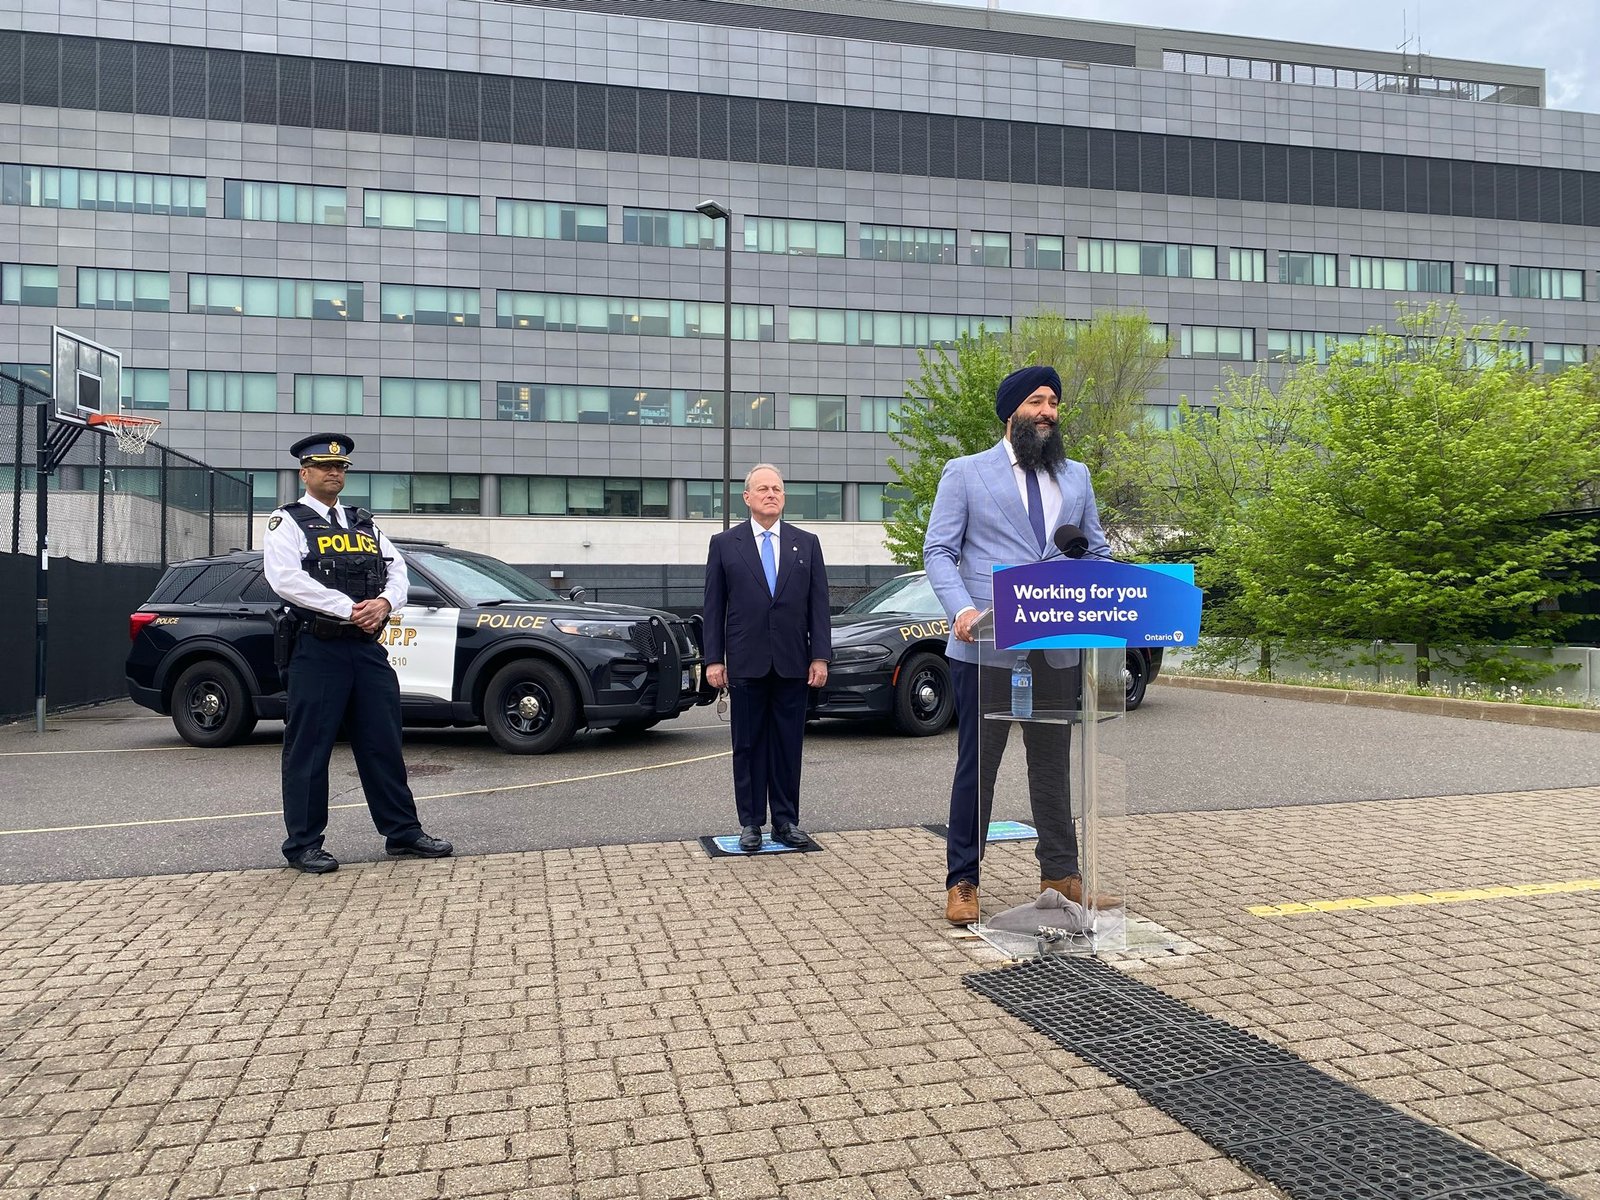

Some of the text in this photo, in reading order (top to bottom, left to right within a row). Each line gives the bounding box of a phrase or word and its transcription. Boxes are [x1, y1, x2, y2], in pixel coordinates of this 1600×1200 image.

[317, 533, 378, 554] POLICE
[1013, 584, 1148, 603] Working for you
[155, 617, 180, 625] POLICE
[476, 613, 548, 629] POLICE
[1014, 604, 1138, 623] À votre service
[899, 620, 951, 641] POLICE
[1144, 633, 1173, 642] Ontario
